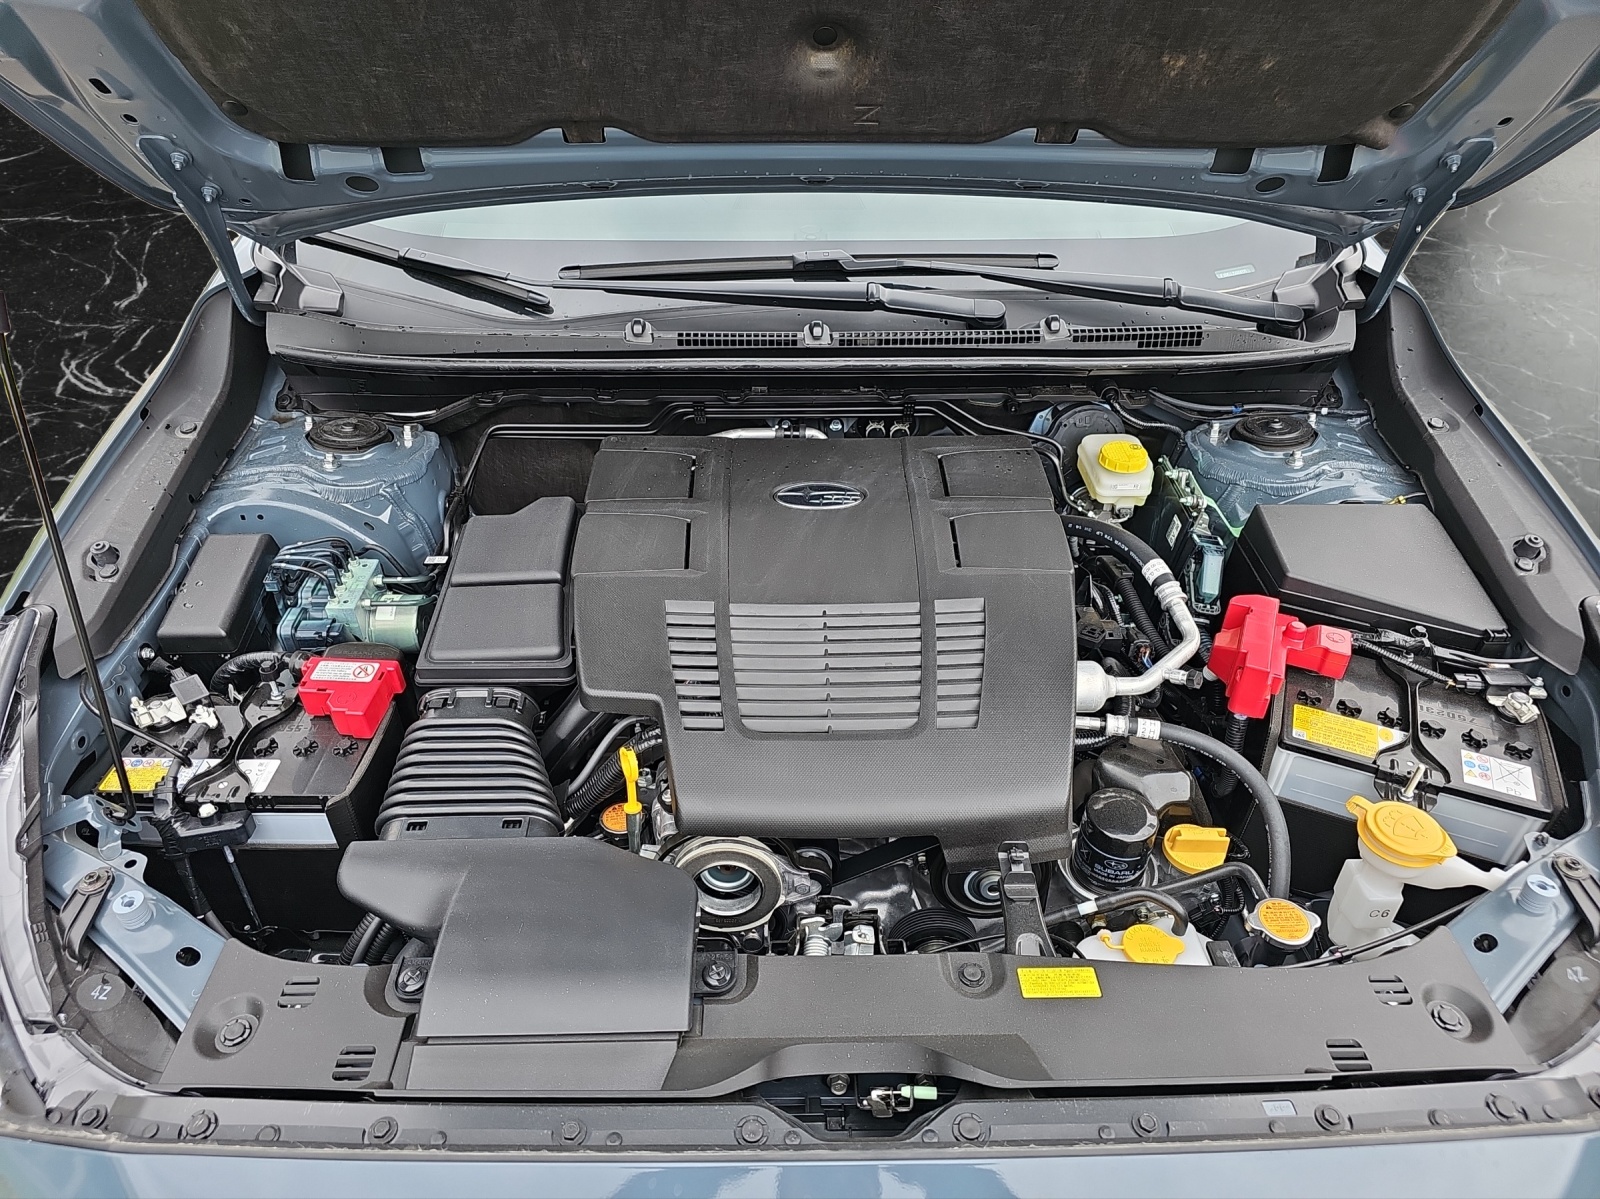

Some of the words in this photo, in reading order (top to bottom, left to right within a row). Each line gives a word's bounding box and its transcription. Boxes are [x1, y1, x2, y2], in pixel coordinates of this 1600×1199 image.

[1506, 787, 1522, 796] Pb
[1094, 863, 1135, 875] SUBARU
[1369, 909, 1391, 918] C6
[1126, 926, 1167, 940] COOLANT
